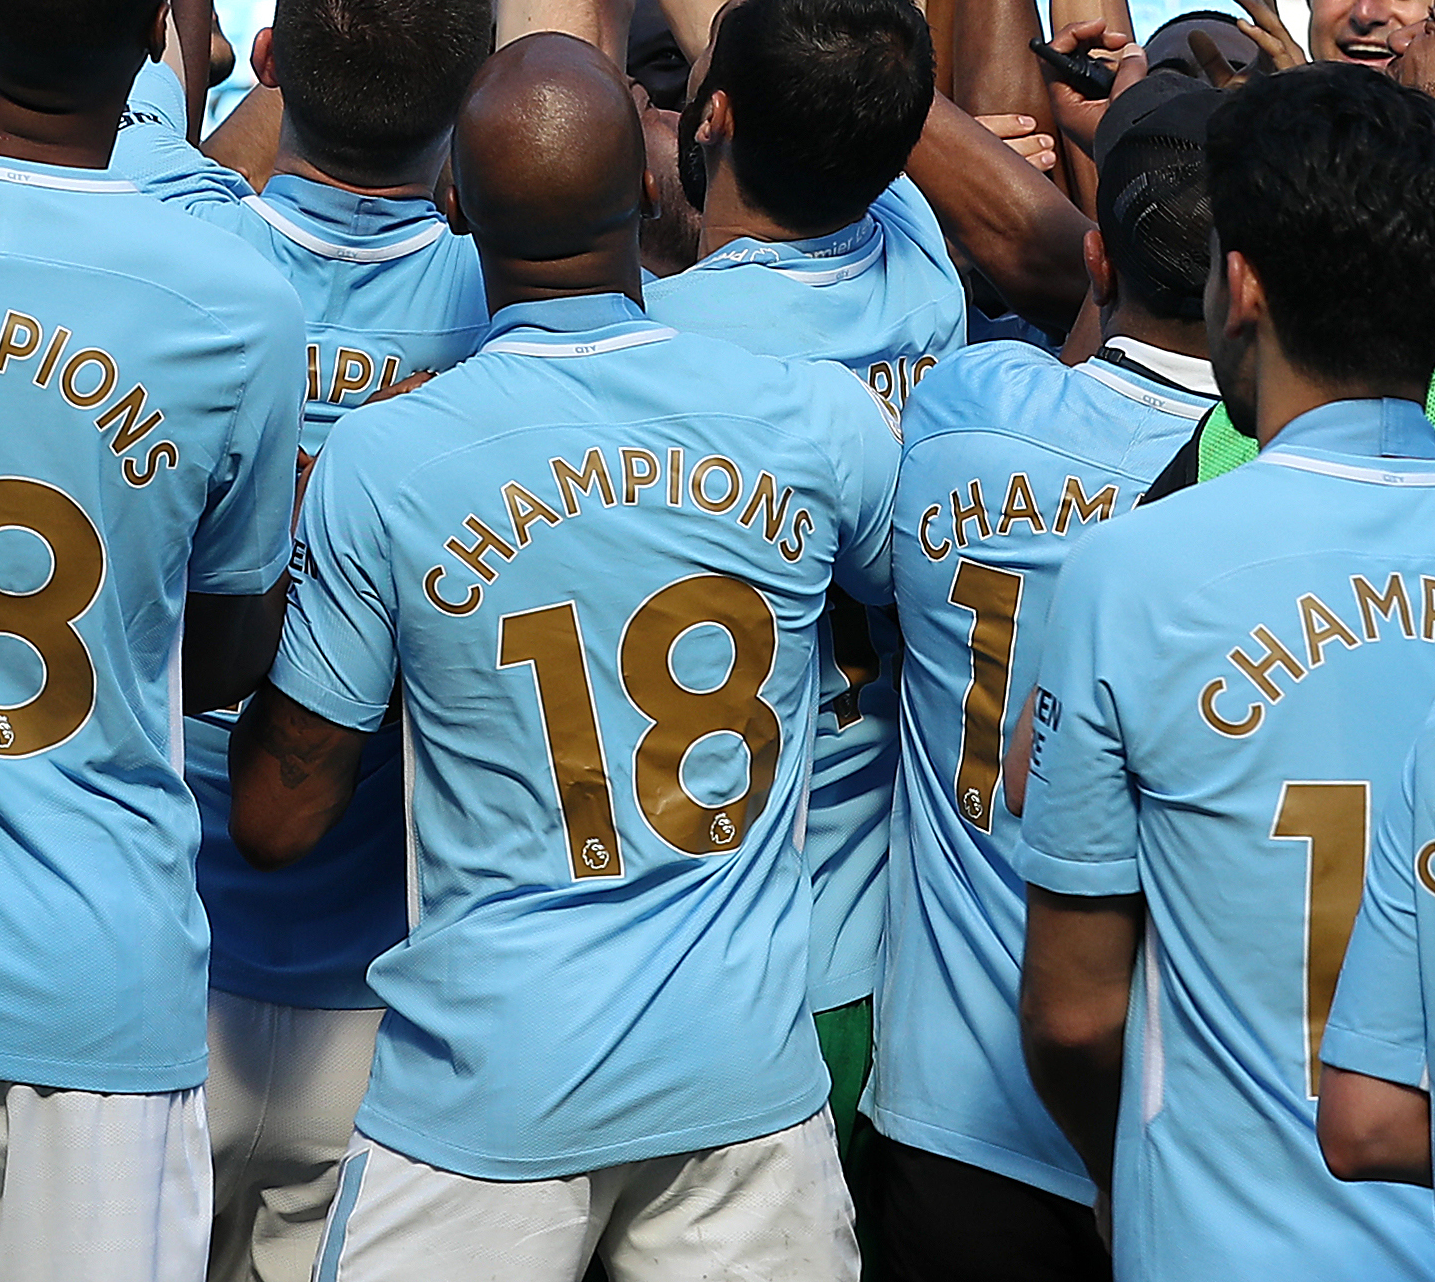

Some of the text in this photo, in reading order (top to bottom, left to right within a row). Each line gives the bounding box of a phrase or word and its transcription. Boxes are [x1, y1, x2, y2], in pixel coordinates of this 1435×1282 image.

[1142, 394, 1166, 407] CITY
[423, 446, 814, 618] CHAMPIONS
[496, 572, 783, 883] 18
